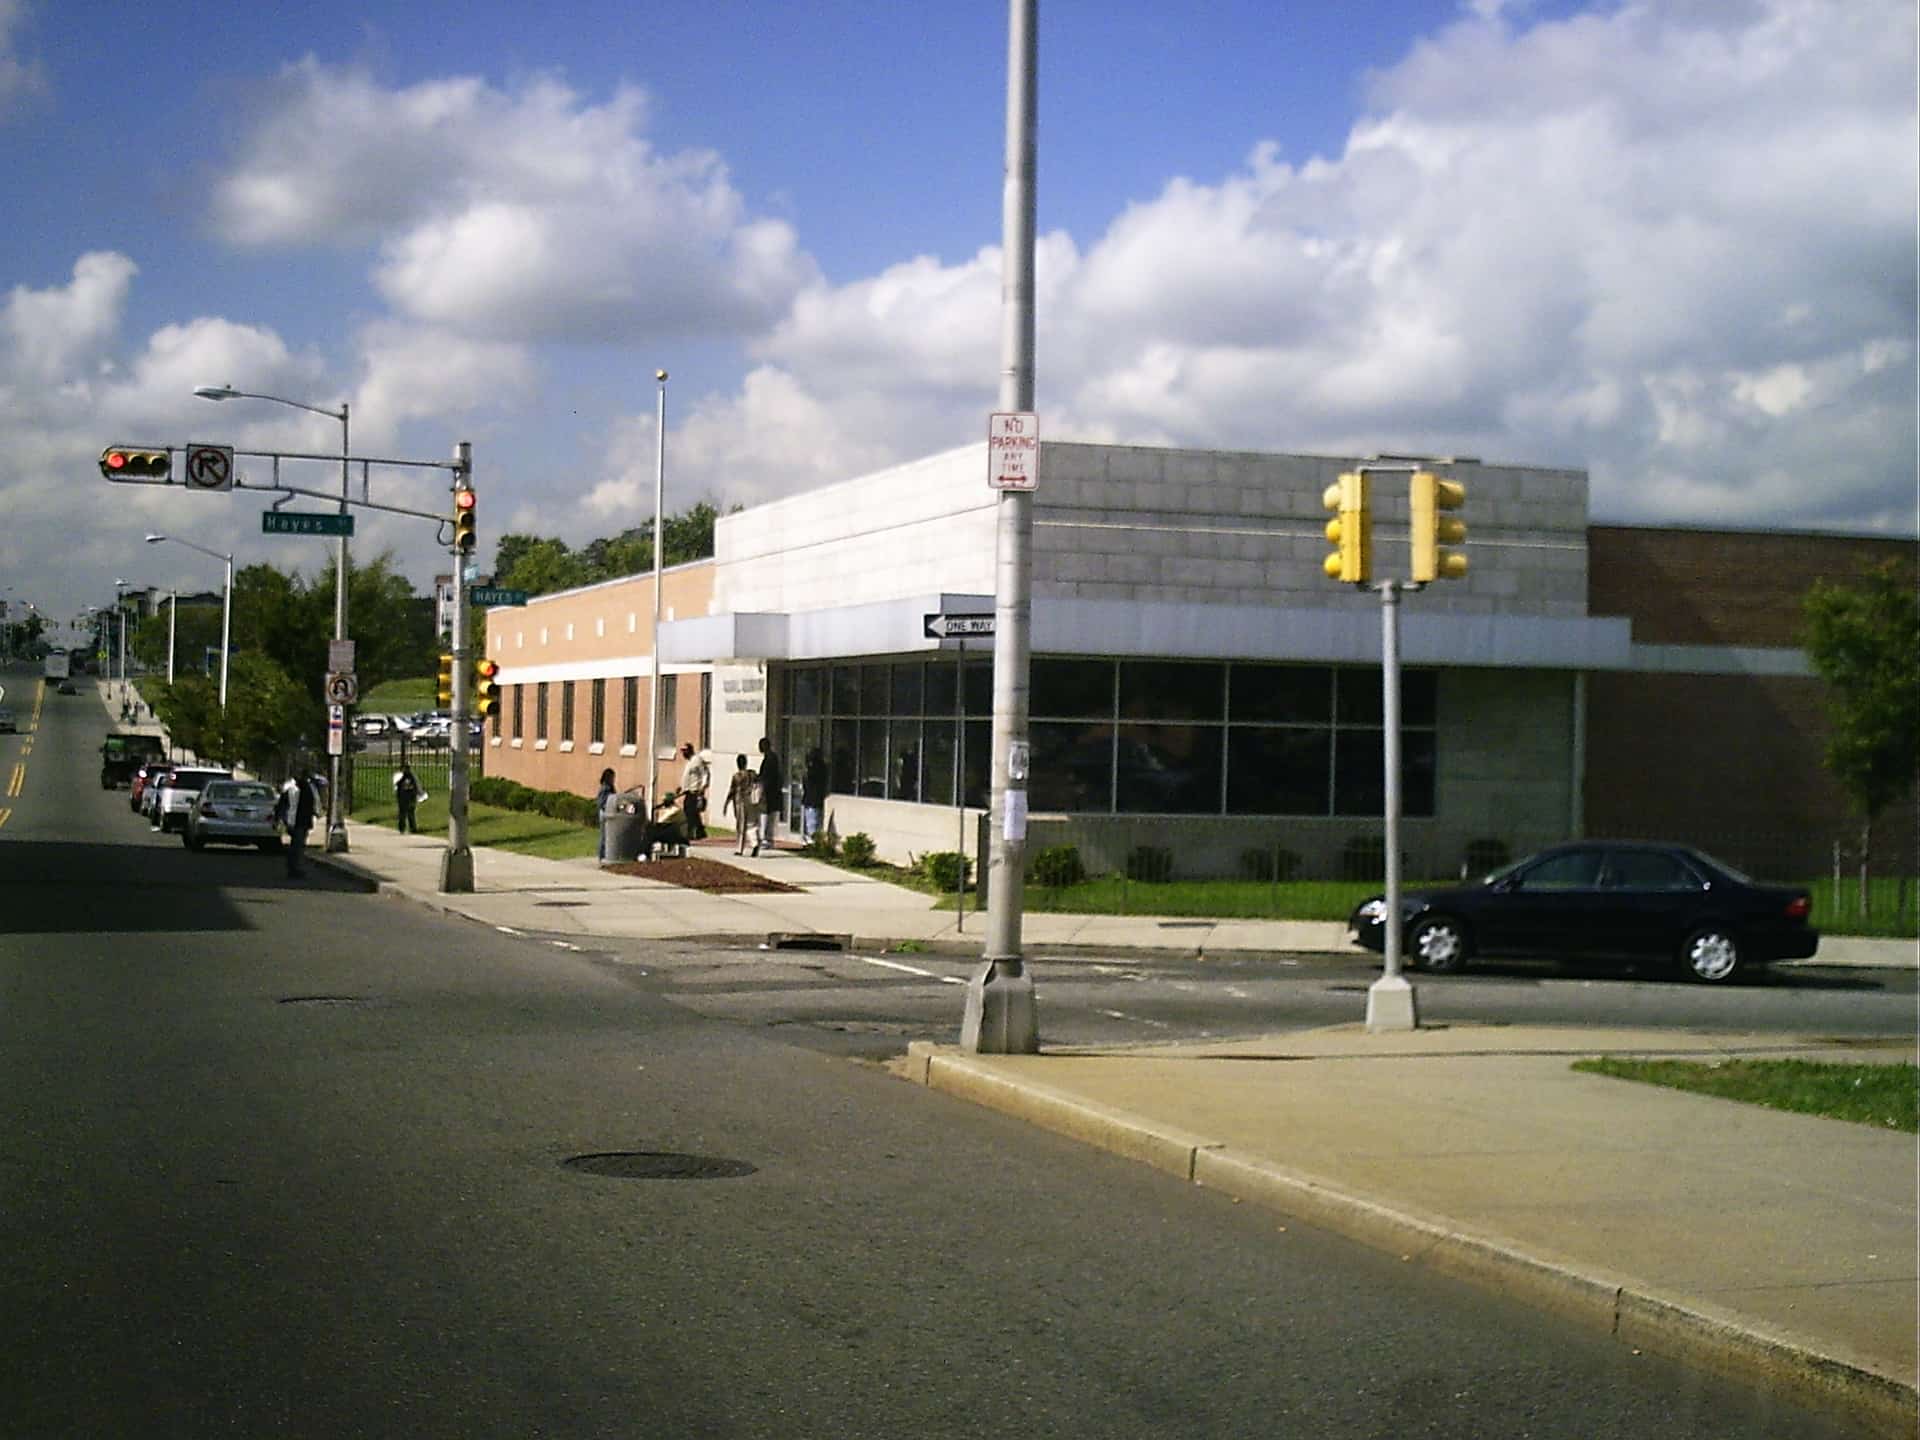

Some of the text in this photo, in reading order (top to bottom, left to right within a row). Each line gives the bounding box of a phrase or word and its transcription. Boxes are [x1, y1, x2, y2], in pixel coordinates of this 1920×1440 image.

[1004, 419, 1024, 433] NO
[991, 436, 1036, 449] PARKING
[267, 516, 322, 532] Hayes
[946, 621, 993, 632] ONE WAY
